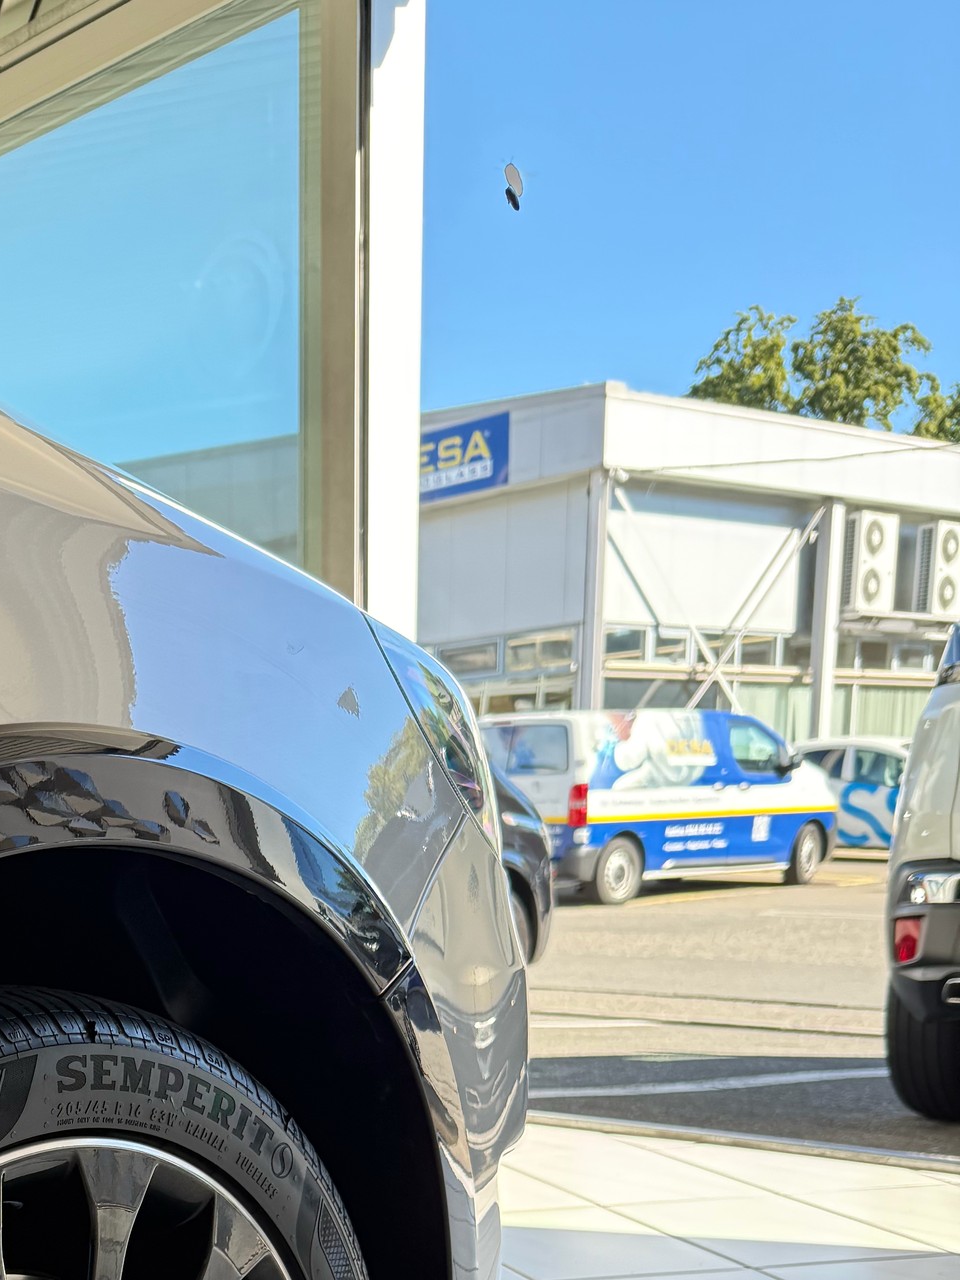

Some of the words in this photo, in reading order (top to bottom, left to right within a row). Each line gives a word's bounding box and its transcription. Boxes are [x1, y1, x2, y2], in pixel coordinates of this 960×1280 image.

[55, 1054, 274, 1157] SEMPERIT
[56, 1100, 108, 1118] 205/45
[114, 1103, 123, 1116] R
[128, 1103, 141, 1118] 16
[149, 1107, 178, 1128] 83W
[185, 1119, 227, 1152] RADIAL
[235, 1151, 279, 1200] TUBELESS
